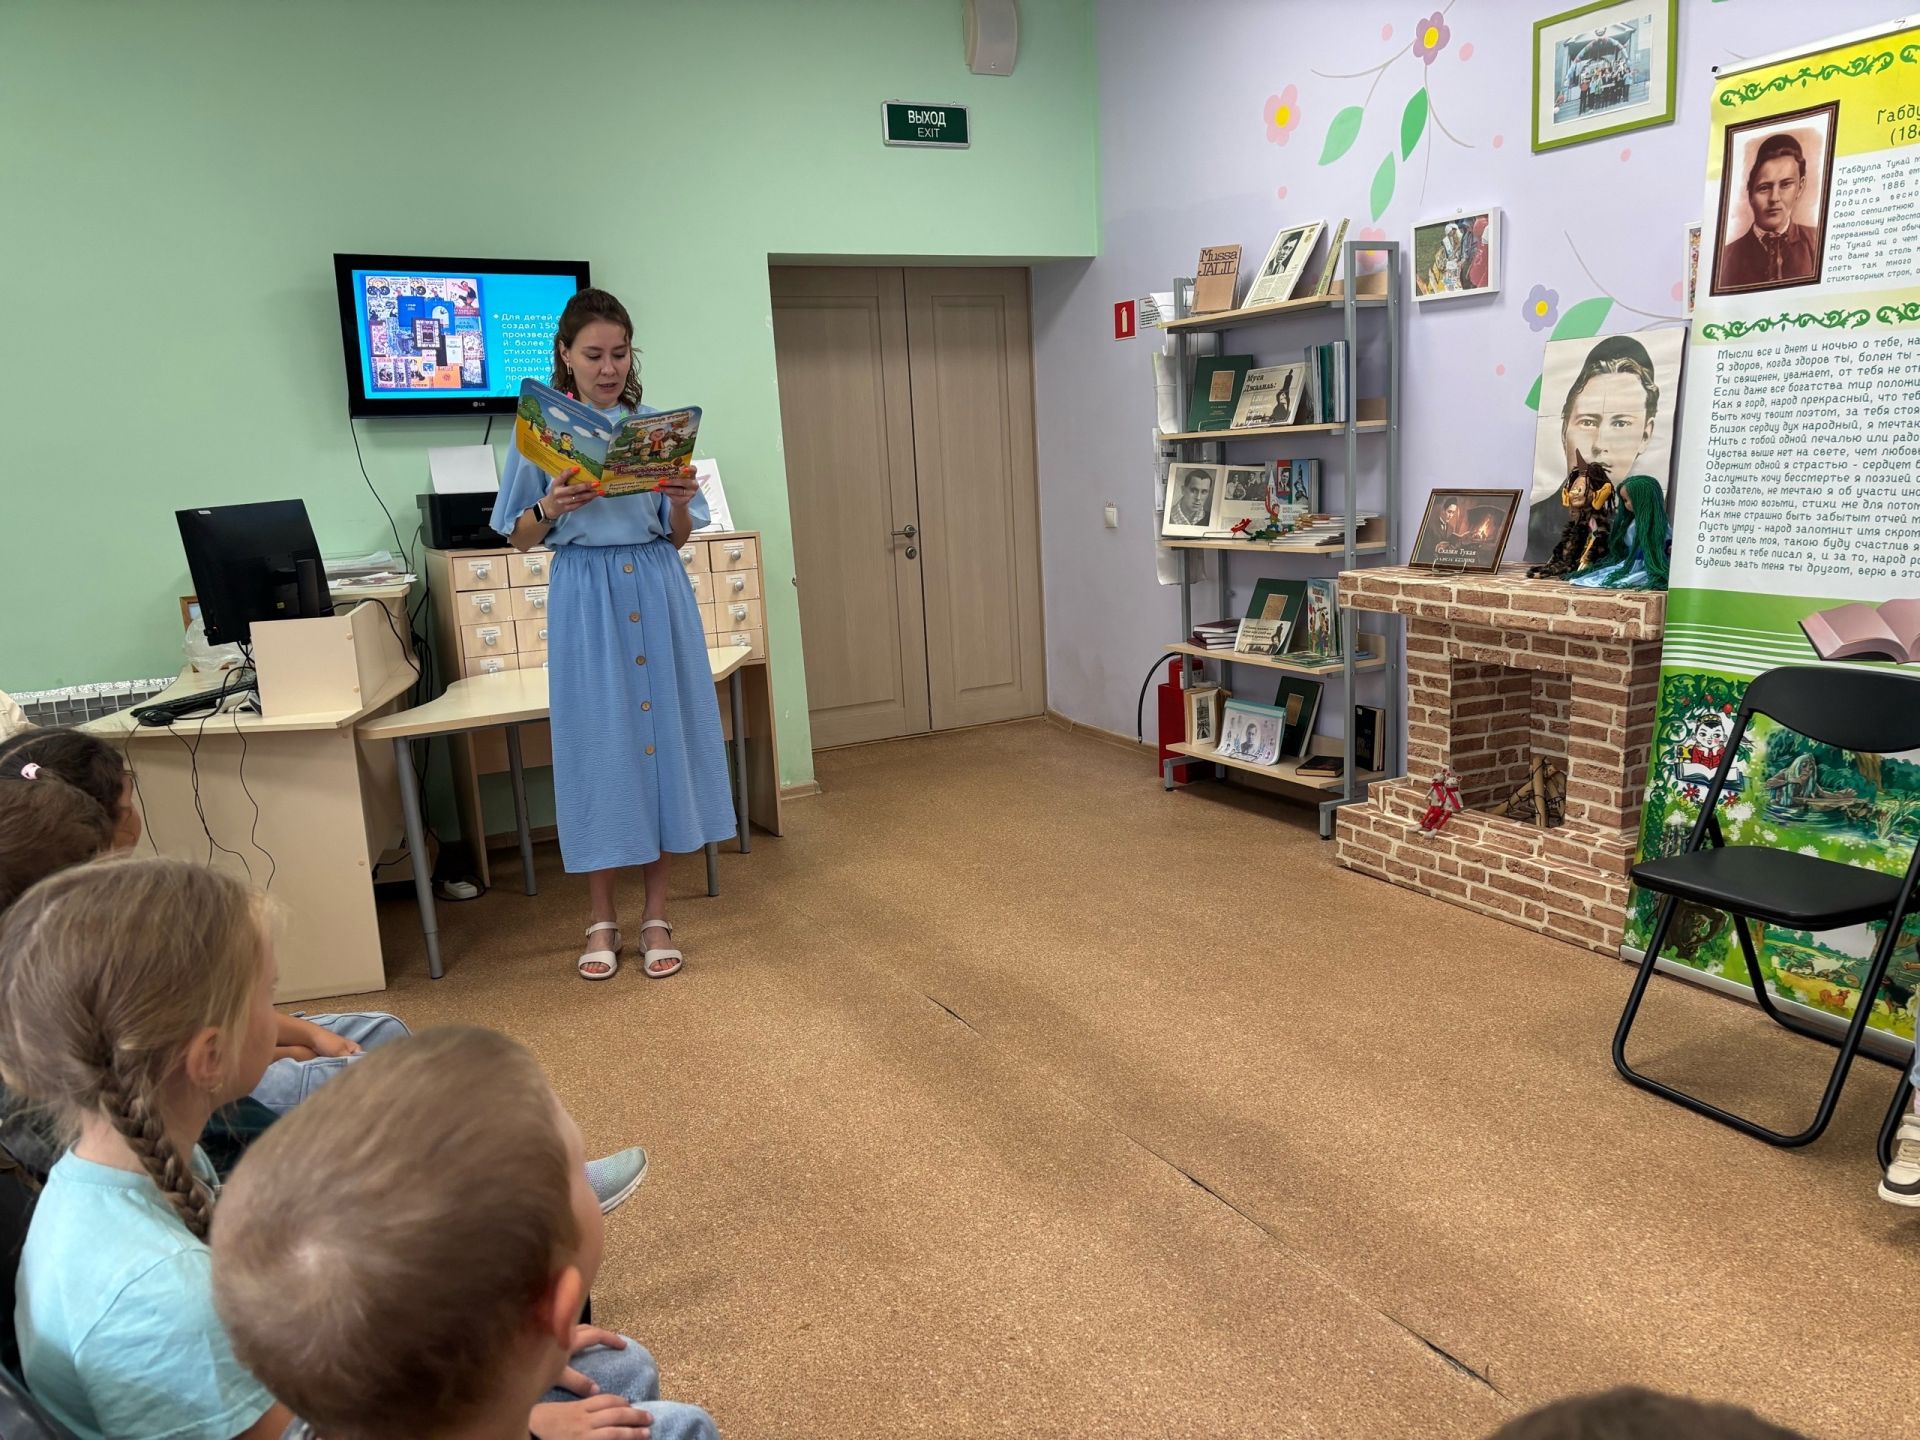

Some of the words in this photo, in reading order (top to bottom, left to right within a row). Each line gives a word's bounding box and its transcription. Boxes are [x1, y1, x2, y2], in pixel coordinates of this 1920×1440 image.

[908, 110, 947, 127] ВЫХОД
[917, 127, 940, 138] EXIT
[1890, 124, 1920, 146] (18
[1887, 157, 1910, 168] Тукай
[1837, 178, 1848, 186] Он
[1853, 175, 1876, 186] умер,
[1881, 170, 1904, 180] когда
[1836, 187, 1872, 197] Апрель
[1882, 179, 1906, 191] 1886
[1835, 196, 1880, 208] Родился
[1833, 210, 1855, 219] Свою
[1861, 202, 1914, 216] семилетнюю
[1831, 228, 1880, 241] прерванный
[1830, 243, 1841, 252] Но
[1847, 240, 1872, 250] Тукай
[1847, 252, 1870, 260] даже
[1889, 247, 1912, 255] столь
[1200, 249, 1238, 262] Mussa
[1198, 260, 1236, 277] JALIL
[1828, 264, 1852, 273] спеть
[1886, 258, 1912, 267] много
[1827, 273, 1885, 283] стихотворных
[501, 313, 520, 321] Для
[524, 313, 553, 321] детей
[501, 322, 536, 330] создал
[515, 339, 544, 347] более
[1717, 349, 1753, 360] Мысли
[1757, 348, 1772, 356] все
[1775, 347, 1781, 355] и
[1784, 344, 1808, 354] днем
[1811, 343, 1817, 351] и
[1821, 341, 1858, 351] ночью
[1862, 341, 1869, 349] о
[1874, 336, 1903, 348] тебе,
[505, 365, 551, 373] прозаиче
[1716, 362, 1725, 372] Я
[1728, 361, 1763, 373] здоров,
[1766, 358, 1792, 368] когда
[1795, 355, 1829, 367] здоров
[1834, 355, 1853, 364] ты,
[1858, 351, 1893, 362] болен
[1897, 352, 1912, 360] ты
[1716, 375, 1730, 385] Ты
[1734, 373, 1780, 384] священен,
[1783, 369, 1833, 382] уважаем,
[1838, 368, 1852, 377] от
[1857, 364, 1884, 375] тебя
[1888, 365, 1901, 374] не
[1713, 386, 1740, 397] Если
[1744, 385, 1767, 395] даже
[1770, 385, 1786, 393] все
[1788, 382, 1843, 393] богатства
[1848, 381, 1873, 392] мир
[1711, 411, 1738, 421] Быть
[1741, 412, 1761, 422] хочу
[1764, 410, 1793, 419] твоим
[1796, 408, 1840, 418] поэтом,
[1846, 408, 1859, 416] за
[1864, 405, 1889, 416] тебя
[1710, 423, 1746, 434] Близок
[1749, 422, 1780, 434] сердцу
[1782, 421, 1799, 433] дух
[1802, 420, 1862, 432] народный,
[1867, 421, 1874, 429] я
[1707, 448, 1748, 460] Чувства
[1751, 449, 1774, 458] выше
[1777, 448, 1793, 457] нет
[1796, 447, 1809, 457] на
[1813, 448, 1850, 458] свете,
[1855, 447, 1877, 456] чем
[1705, 460, 1752, 472] Одержим
[1754, 460, 1780, 470] одной
[1784, 461, 1789, 469] я
[1792, 460, 1848, 472] страстью
[1862, 459, 1912, 471] сердцем
[1703, 484, 1711, 494] О
[1715, 484, 1764, 496] создатель,
[1767, 487, 1778, 495] не
[1780, 486, 1823, 496] мечтаю
[1838, 485, 1852, 496] об
[1856, 487, 1897, 499] участи
[1698, 521, 1729, 532] Пусть
[1731, 523, 1755, 535] умру
[1764, 523, 1792, 535] народ
[1795, 525, 1853, 536] запомнит
[1857, 527, 1881, 536] имя
[1698, 532, 1706, 542] В
[1709, 534, 1734, 543] этом
[1736, 535, 1757, 545] цель
[1759, 537, 1780, 547] моя,
[1784, 537, 1819, 547] такою
[1823, 537, 1851, 551] буду
[1854, 540, 1909, 551] счастлив
[1913, 542, 1920, 551] я
[1696, 544, 1705, 554] О
[1708, 545, 1738, 556] любви
[1749, 547, 1769, 557] тебе
[1771, 549, 1803, 559] писал
[1806, 551, 1816, 561] я,
[1821, 552, 1828, 561] и
[1834, 552, 1846, 561] за
[1851, 553, 1868, 563] то,
[1872, 553, 1906, 566] народ
[1695, 556, 1732, 568] Будешь
[1734, 559, 1759, 569] звать
[1761, 562, 1785, 571] меня
[1788, 564, 1803, 572] ты
[1806, 562, 1853, 576] другом,
[1858, 567, 1887, 578] верю
[1890, 569, 1897, 577] в
